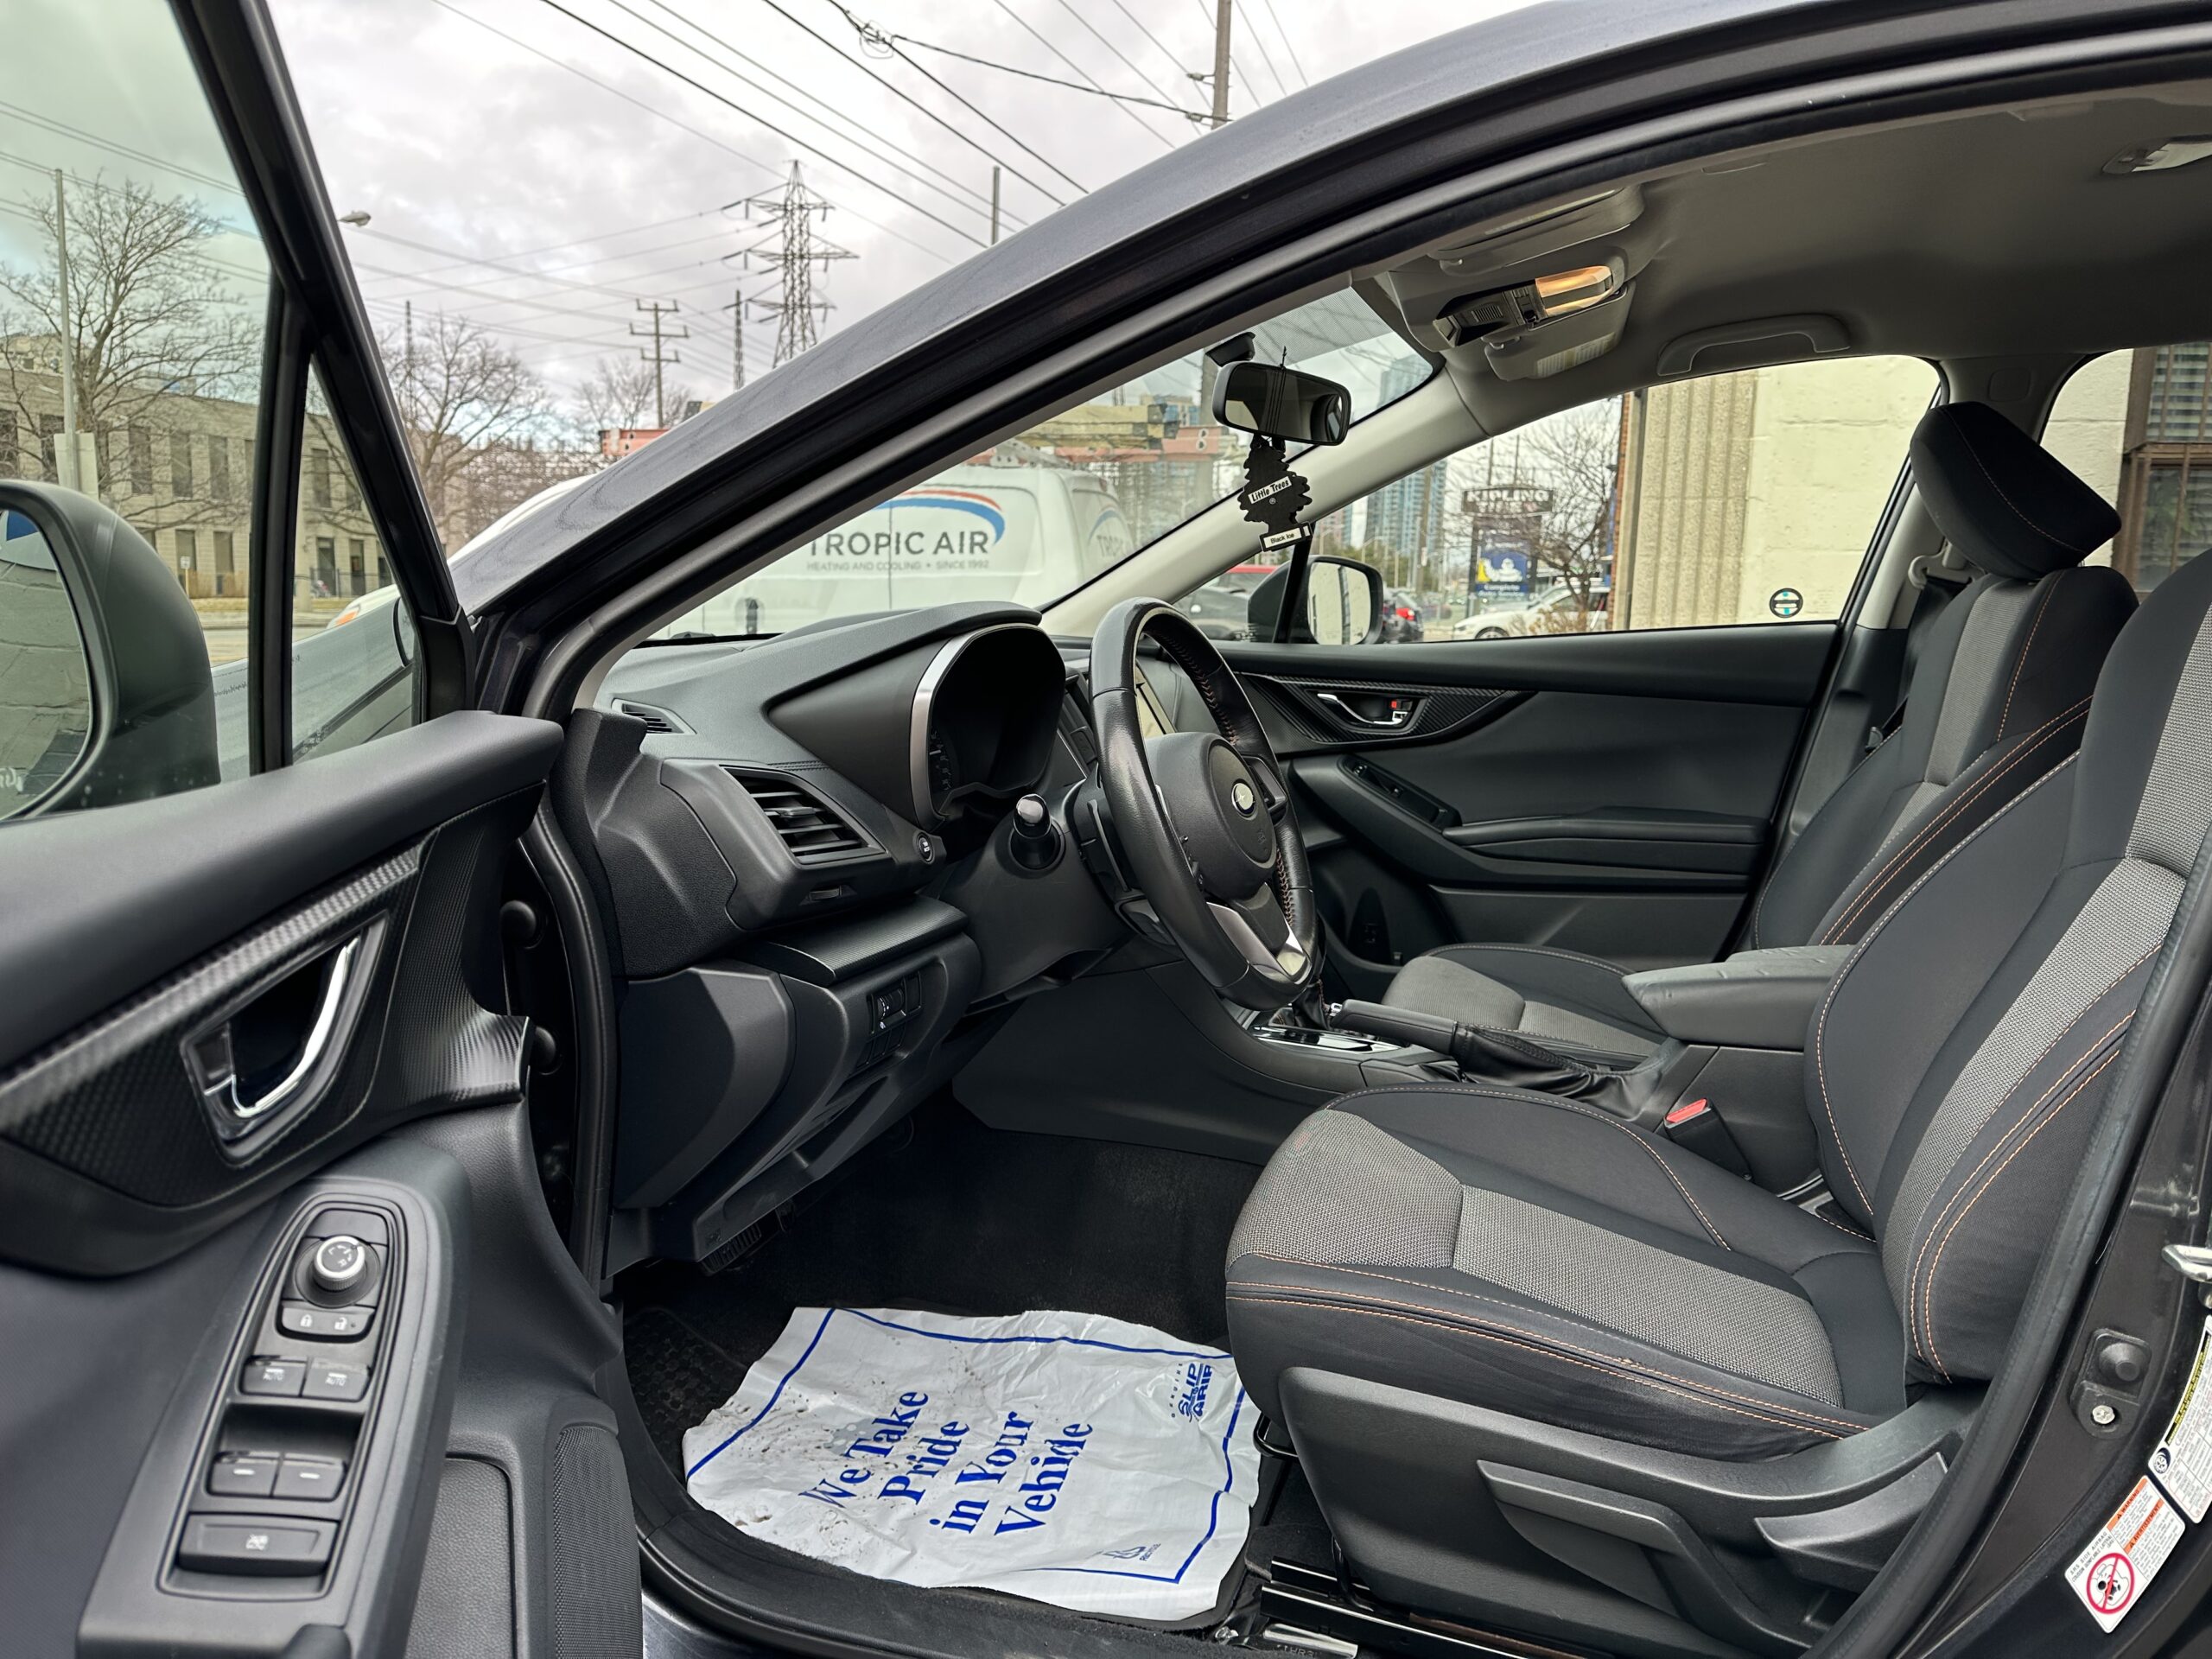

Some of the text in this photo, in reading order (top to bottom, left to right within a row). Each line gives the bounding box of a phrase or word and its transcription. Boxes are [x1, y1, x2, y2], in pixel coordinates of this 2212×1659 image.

[1251, 479, 1289, 502] Little Trees
[932, 531, 988, 555] AIR
[1270, 535, 1286, 544] Black
[806, 562, 850, 571] HEATING
[852, 562, 874, 571] AND
[876, 561, 922, 571] COOLING
[936, 560, 965, 570] SINCE
[1178, 1363, 1198, 1417] SLIP
[798, 1391, 929, 1509] We Take
[878, 1421, 970, 1505] Pride
[930, 1411, 1034, 1535] in Your
[994, 1422, 1094, 1536] Vehicle
[2121, 1489, 2140, 1514] WARNING
[2133, 1505, 2161, 1542] AVERTISSEMENT
[2091, 1532, 2107, 1551] AIRBAG
